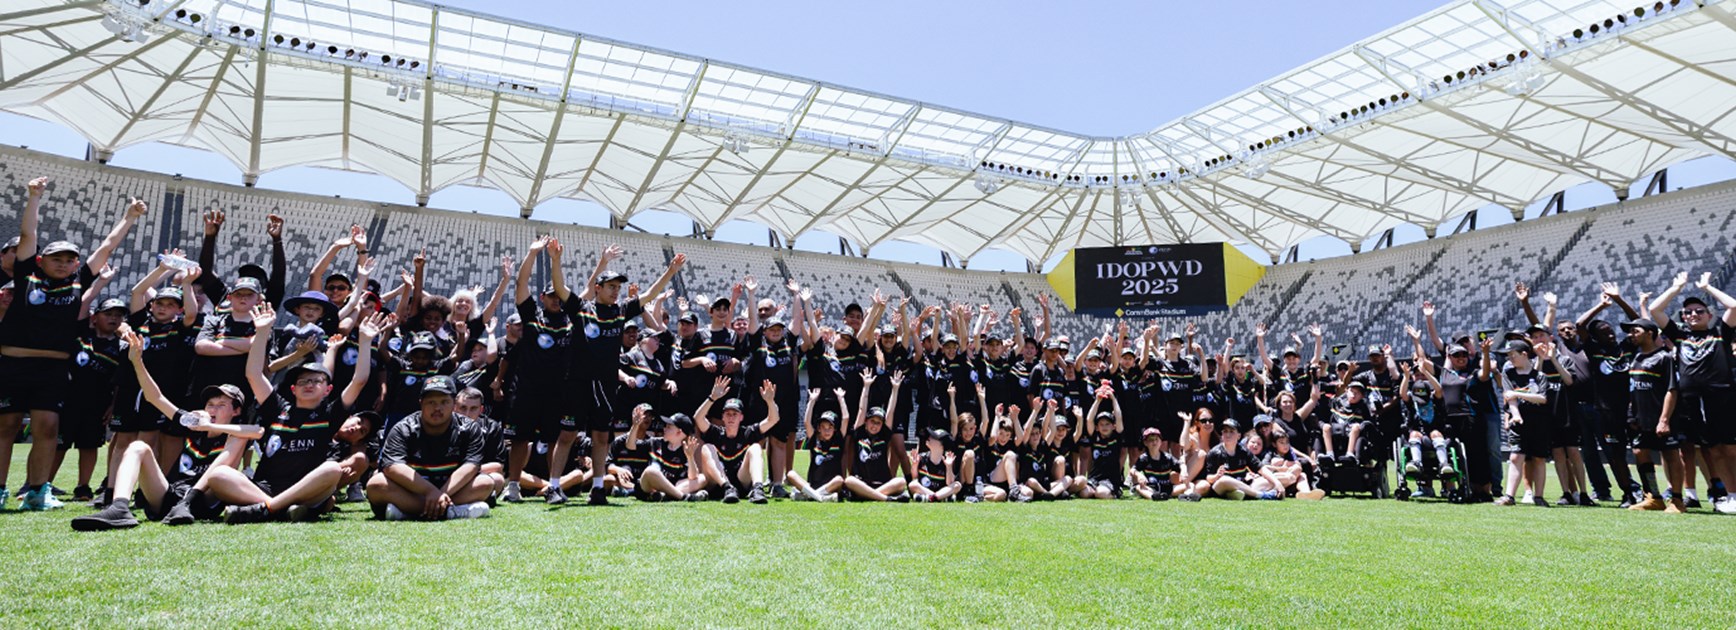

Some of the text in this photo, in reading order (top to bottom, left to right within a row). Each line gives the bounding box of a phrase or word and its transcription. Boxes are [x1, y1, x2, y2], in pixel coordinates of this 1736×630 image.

[1096, 260, 1203, 279] IDOPWD
[1121, 278, 1179, 296] 2025
[1125, 307, 1186, 316] CommBank Stadium
[281, 439, 315, 450] ZENN
